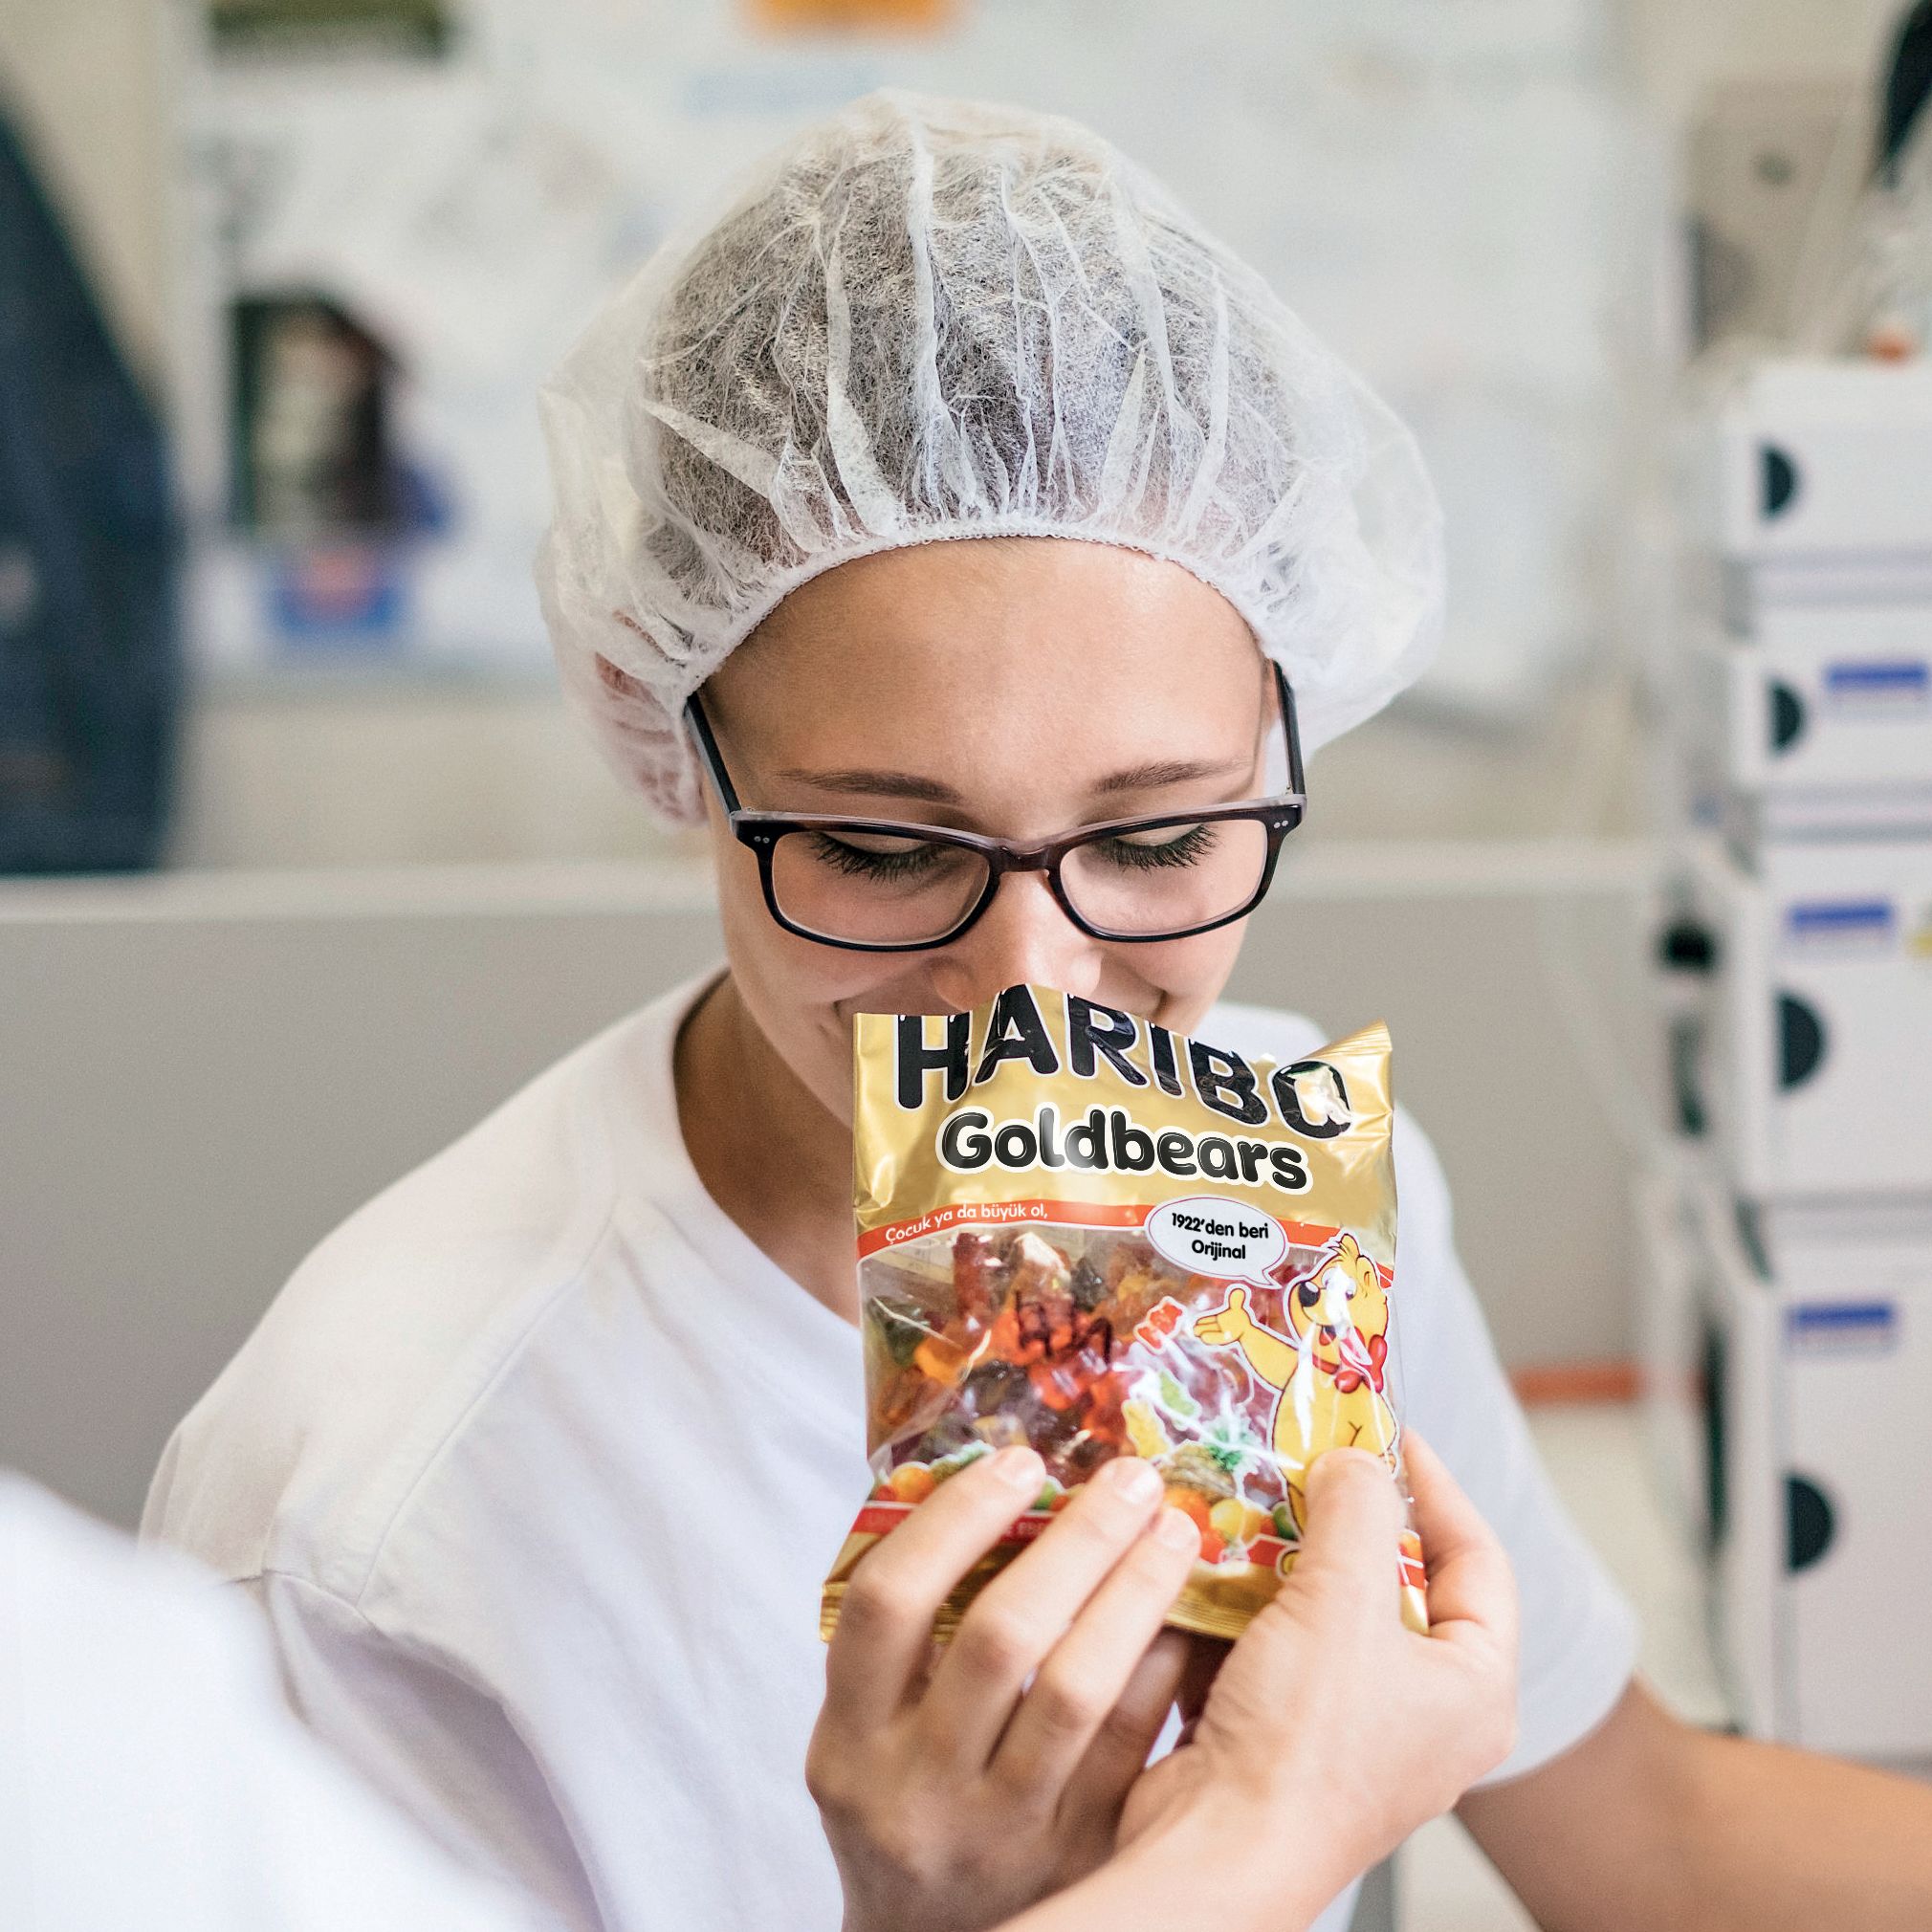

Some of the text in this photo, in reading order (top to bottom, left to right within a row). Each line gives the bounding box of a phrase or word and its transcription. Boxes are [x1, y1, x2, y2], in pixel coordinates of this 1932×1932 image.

[896, 983, 1351, 1139] HARIBO
[942, 1107, 1307, 1190] Goldbears
[886, 1203, 1048, 1244] Çocuk ya da büyük ol,
[1239, 1221, 1268, 1239] beri
[1192, 1240, 1245, 1261] Orijinal
